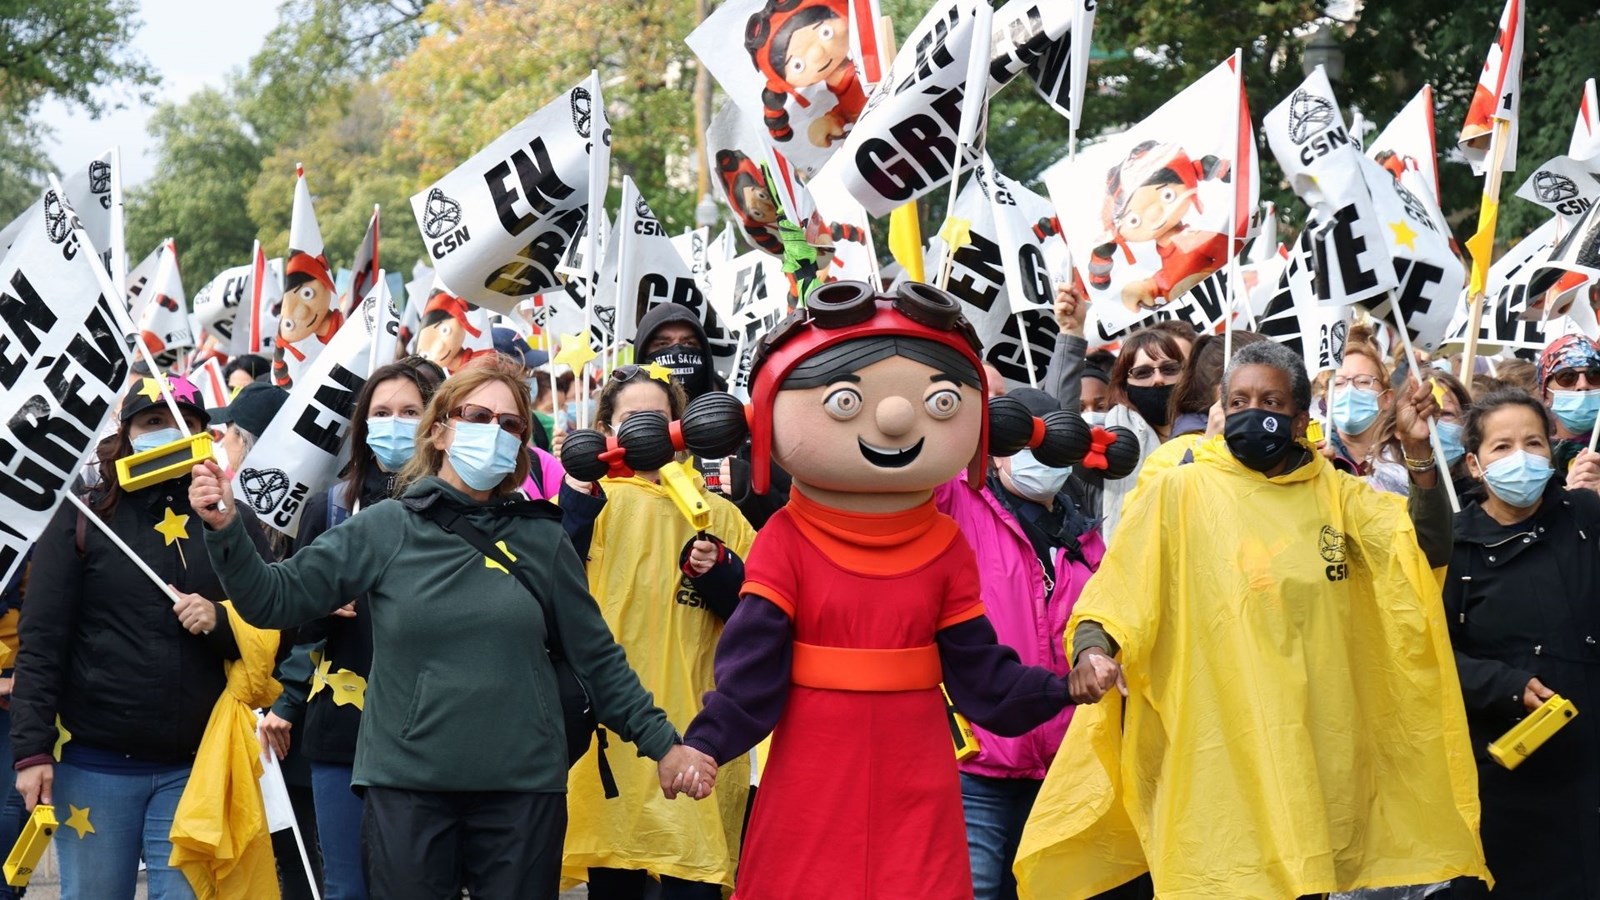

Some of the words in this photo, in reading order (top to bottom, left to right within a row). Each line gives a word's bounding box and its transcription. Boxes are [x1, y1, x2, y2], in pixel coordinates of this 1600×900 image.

[855, 81, 979, 201] GRÈ
[1300, 126, 1349, 166] CSN
[484, 136, 576, 237] EN
[1556, 197, 1591, 216] CSN
[431, 225, 471, 260] CSN
[655, 354, 676, 366] HAIL
[677, 353, 703, 365] SATAN
[1319, 323, 1328, 368] CSN
[273, 482, 310, 528] CSN
